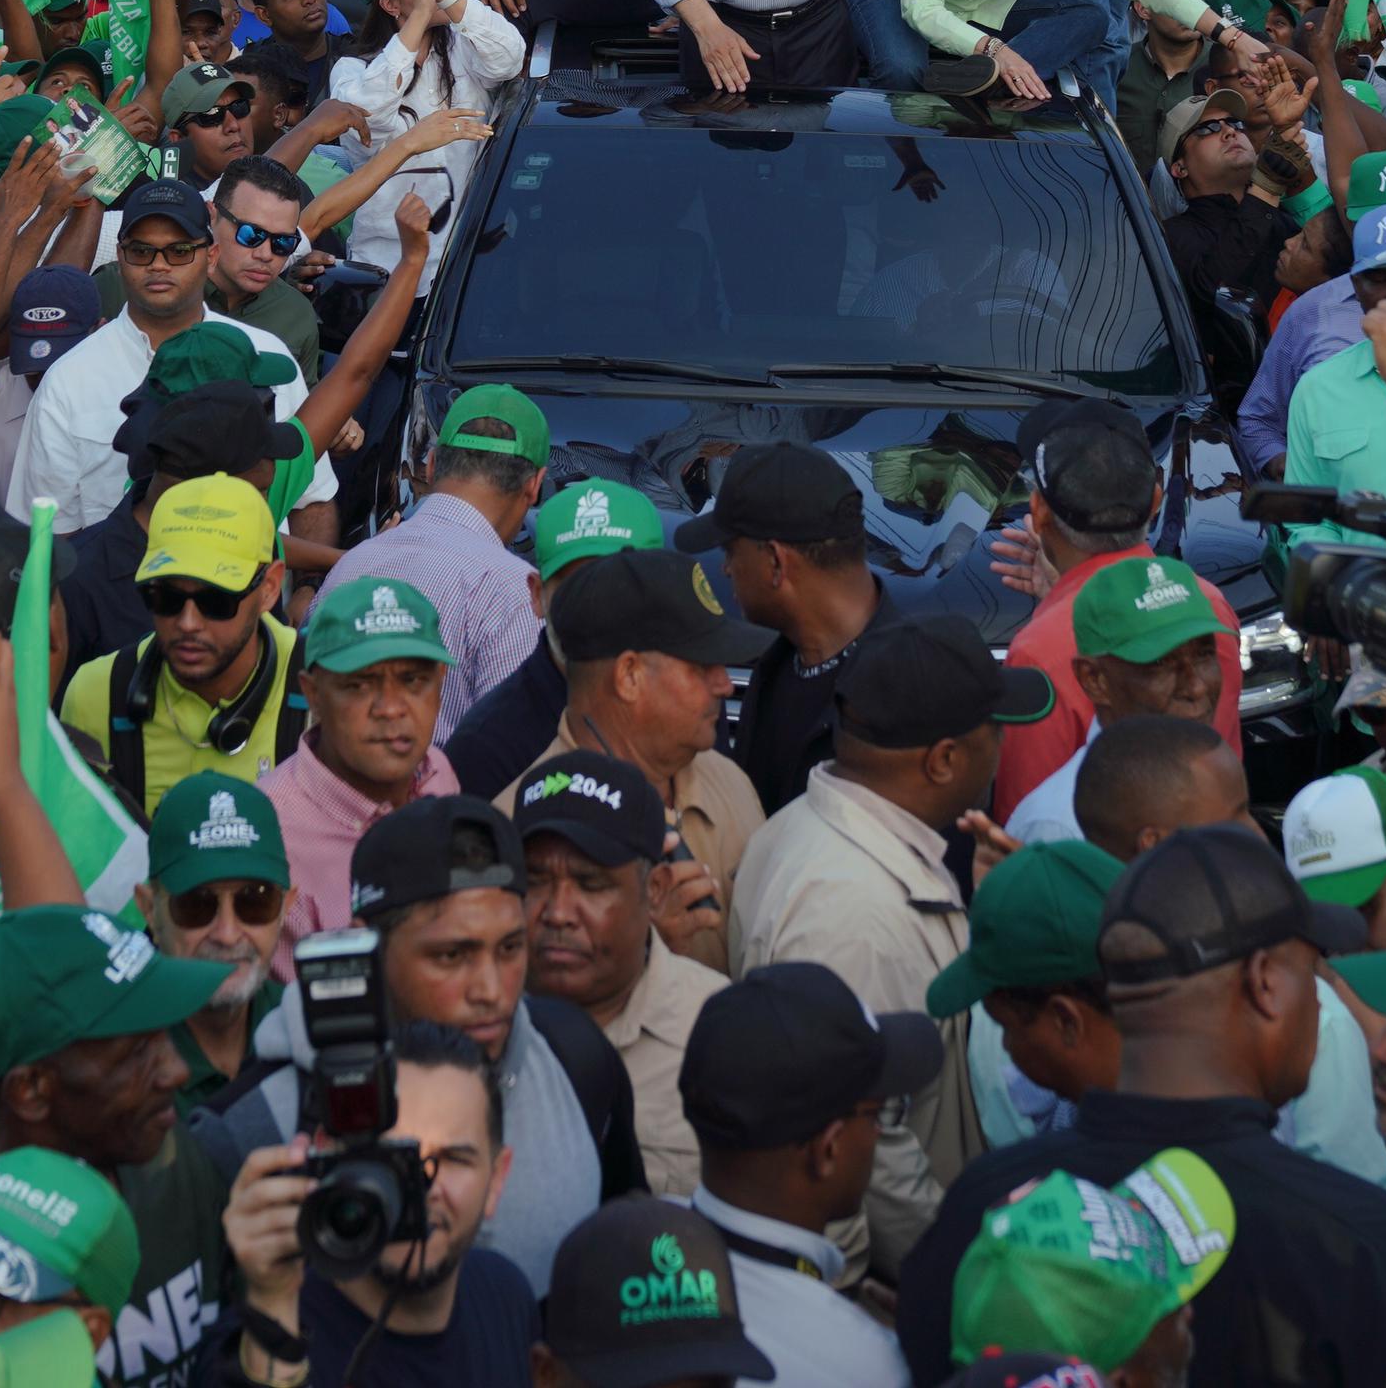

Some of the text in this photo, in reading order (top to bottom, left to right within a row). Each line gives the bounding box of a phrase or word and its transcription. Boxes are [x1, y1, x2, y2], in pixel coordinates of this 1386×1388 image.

[164, 149, 177, 178] FP
[33, 307, 58, 320] NYC
[1134, 583, 1190, 610] LEONEL
[355, 615, 422, 633] LEONEL
[568, 772, 623, 810] 2044
[189, 824, 261, 846] LEONEL
[621, 1269, 719, 1310] OMAR
